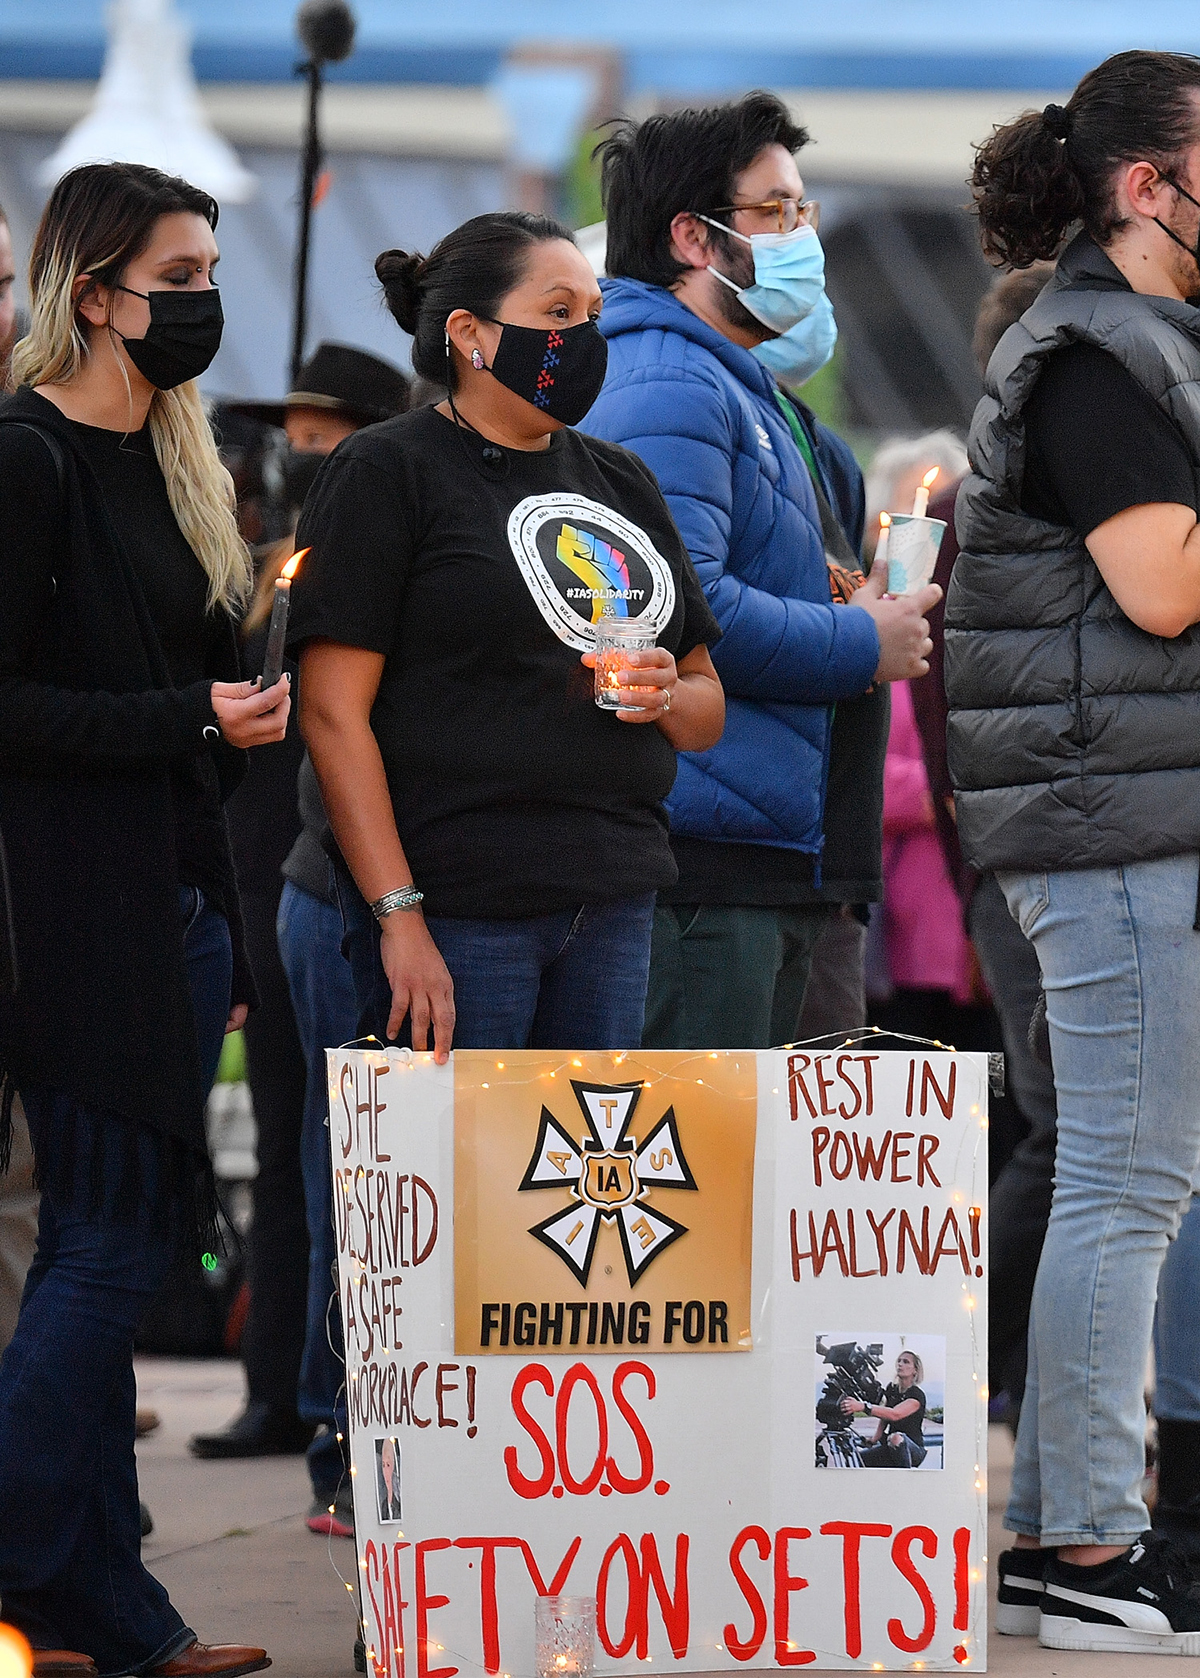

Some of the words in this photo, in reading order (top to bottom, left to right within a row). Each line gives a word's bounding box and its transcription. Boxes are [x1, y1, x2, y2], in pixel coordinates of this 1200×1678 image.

[566, 587, 645, 601] #IASOLIDARITY
[340, 1062, 391, 1163] SHE
[787, 1054, 880, 1122] REST
[905, 1058, 957, 1121] IN
[598, 1166, 622, 1192] IA
[812, 1126, 942, 1188] POWER
[335, 1164, 439, 1275] DESERVED
[790, 1205, 983, 1283] HALYNA!
[481, 1302, 650, 1347] FIGHTING
[664, 1301, 729, 1344] FOR
[348, 1361, 478, 1439] WORKPLACE!
[504, 1360, 670, 1499] S.O.S.
[365, 1536, 582, 1678] SAFETY
[596, 1532, 690, 1660] ON
[723, 1521, 972, 1666] SETS!
